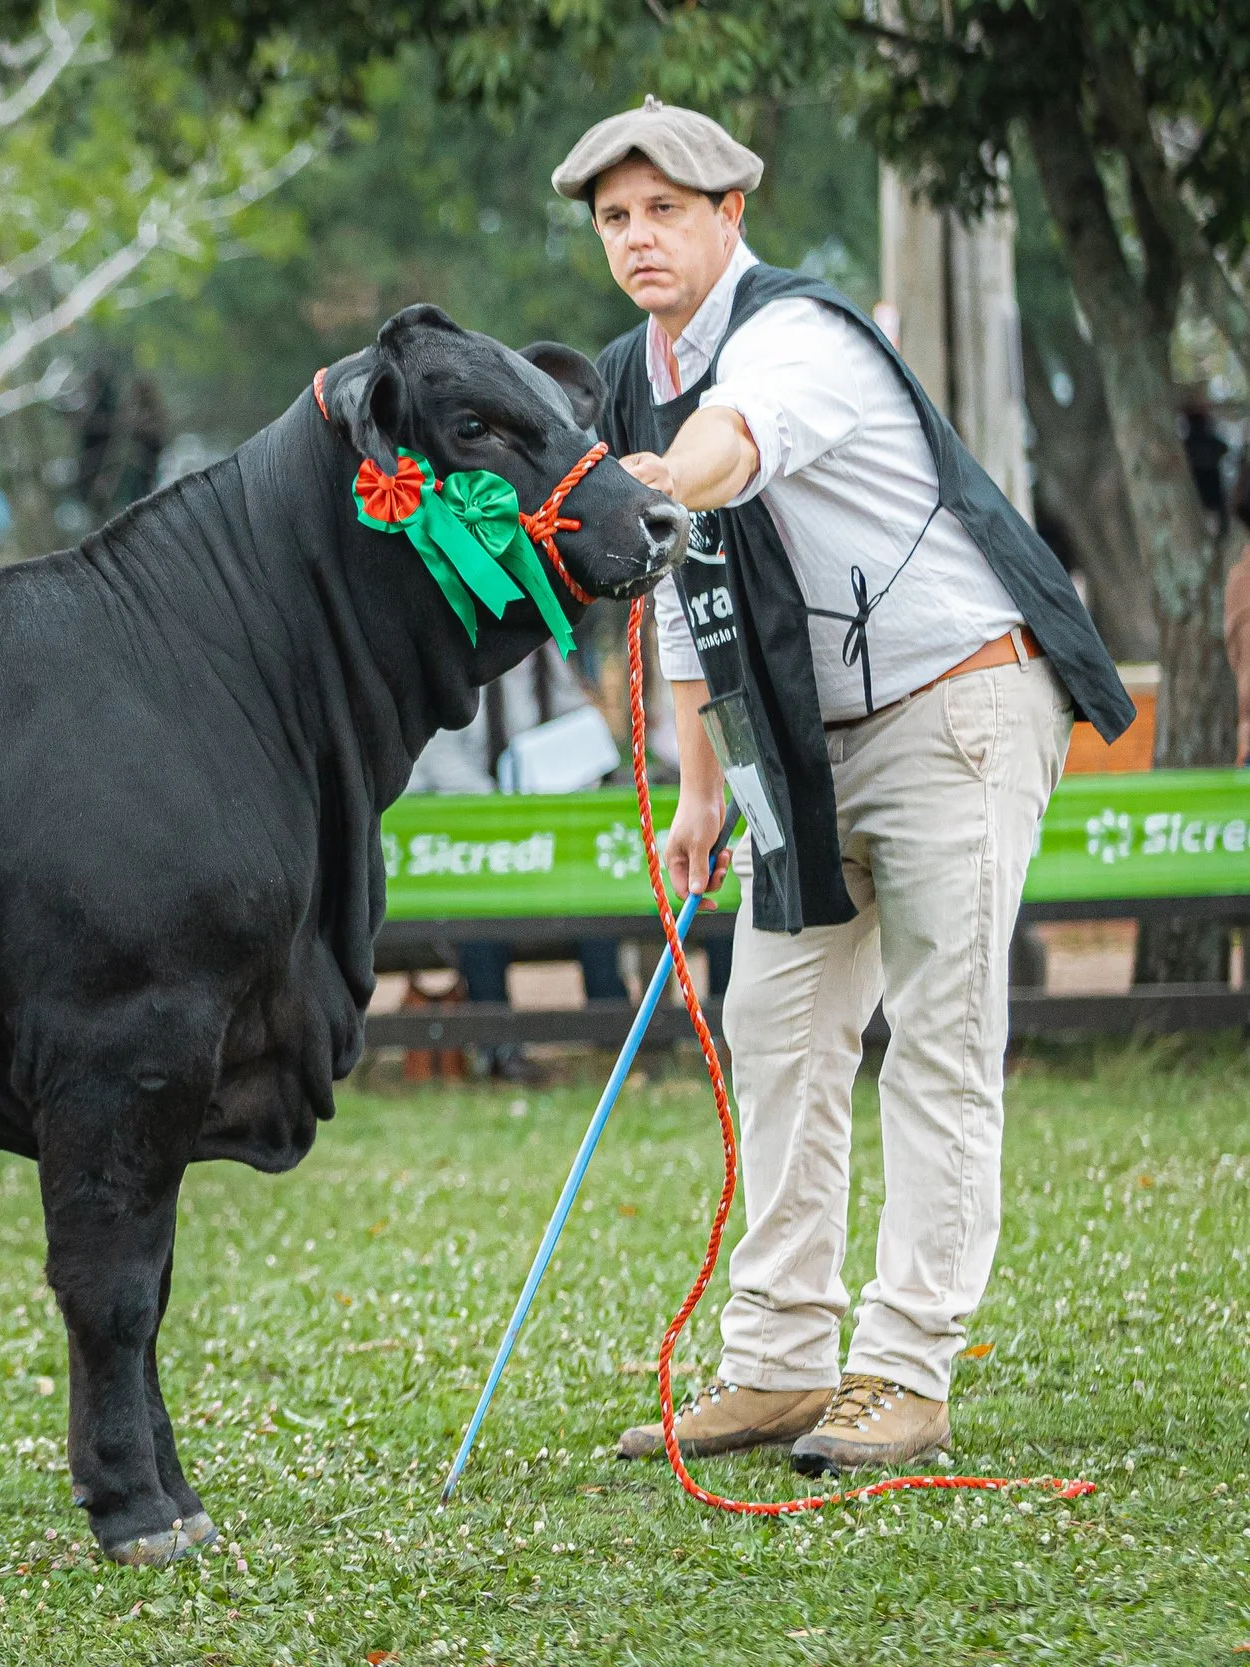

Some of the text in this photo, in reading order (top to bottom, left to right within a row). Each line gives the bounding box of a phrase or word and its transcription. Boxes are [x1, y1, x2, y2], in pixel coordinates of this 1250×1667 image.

[686, 586, 734, 628] ra
[696, 628, 732, 651] OCIAÇÃO
[407, 832, 555, 875] Sicredi
[1142, 813, 1250, 856] Sicre
